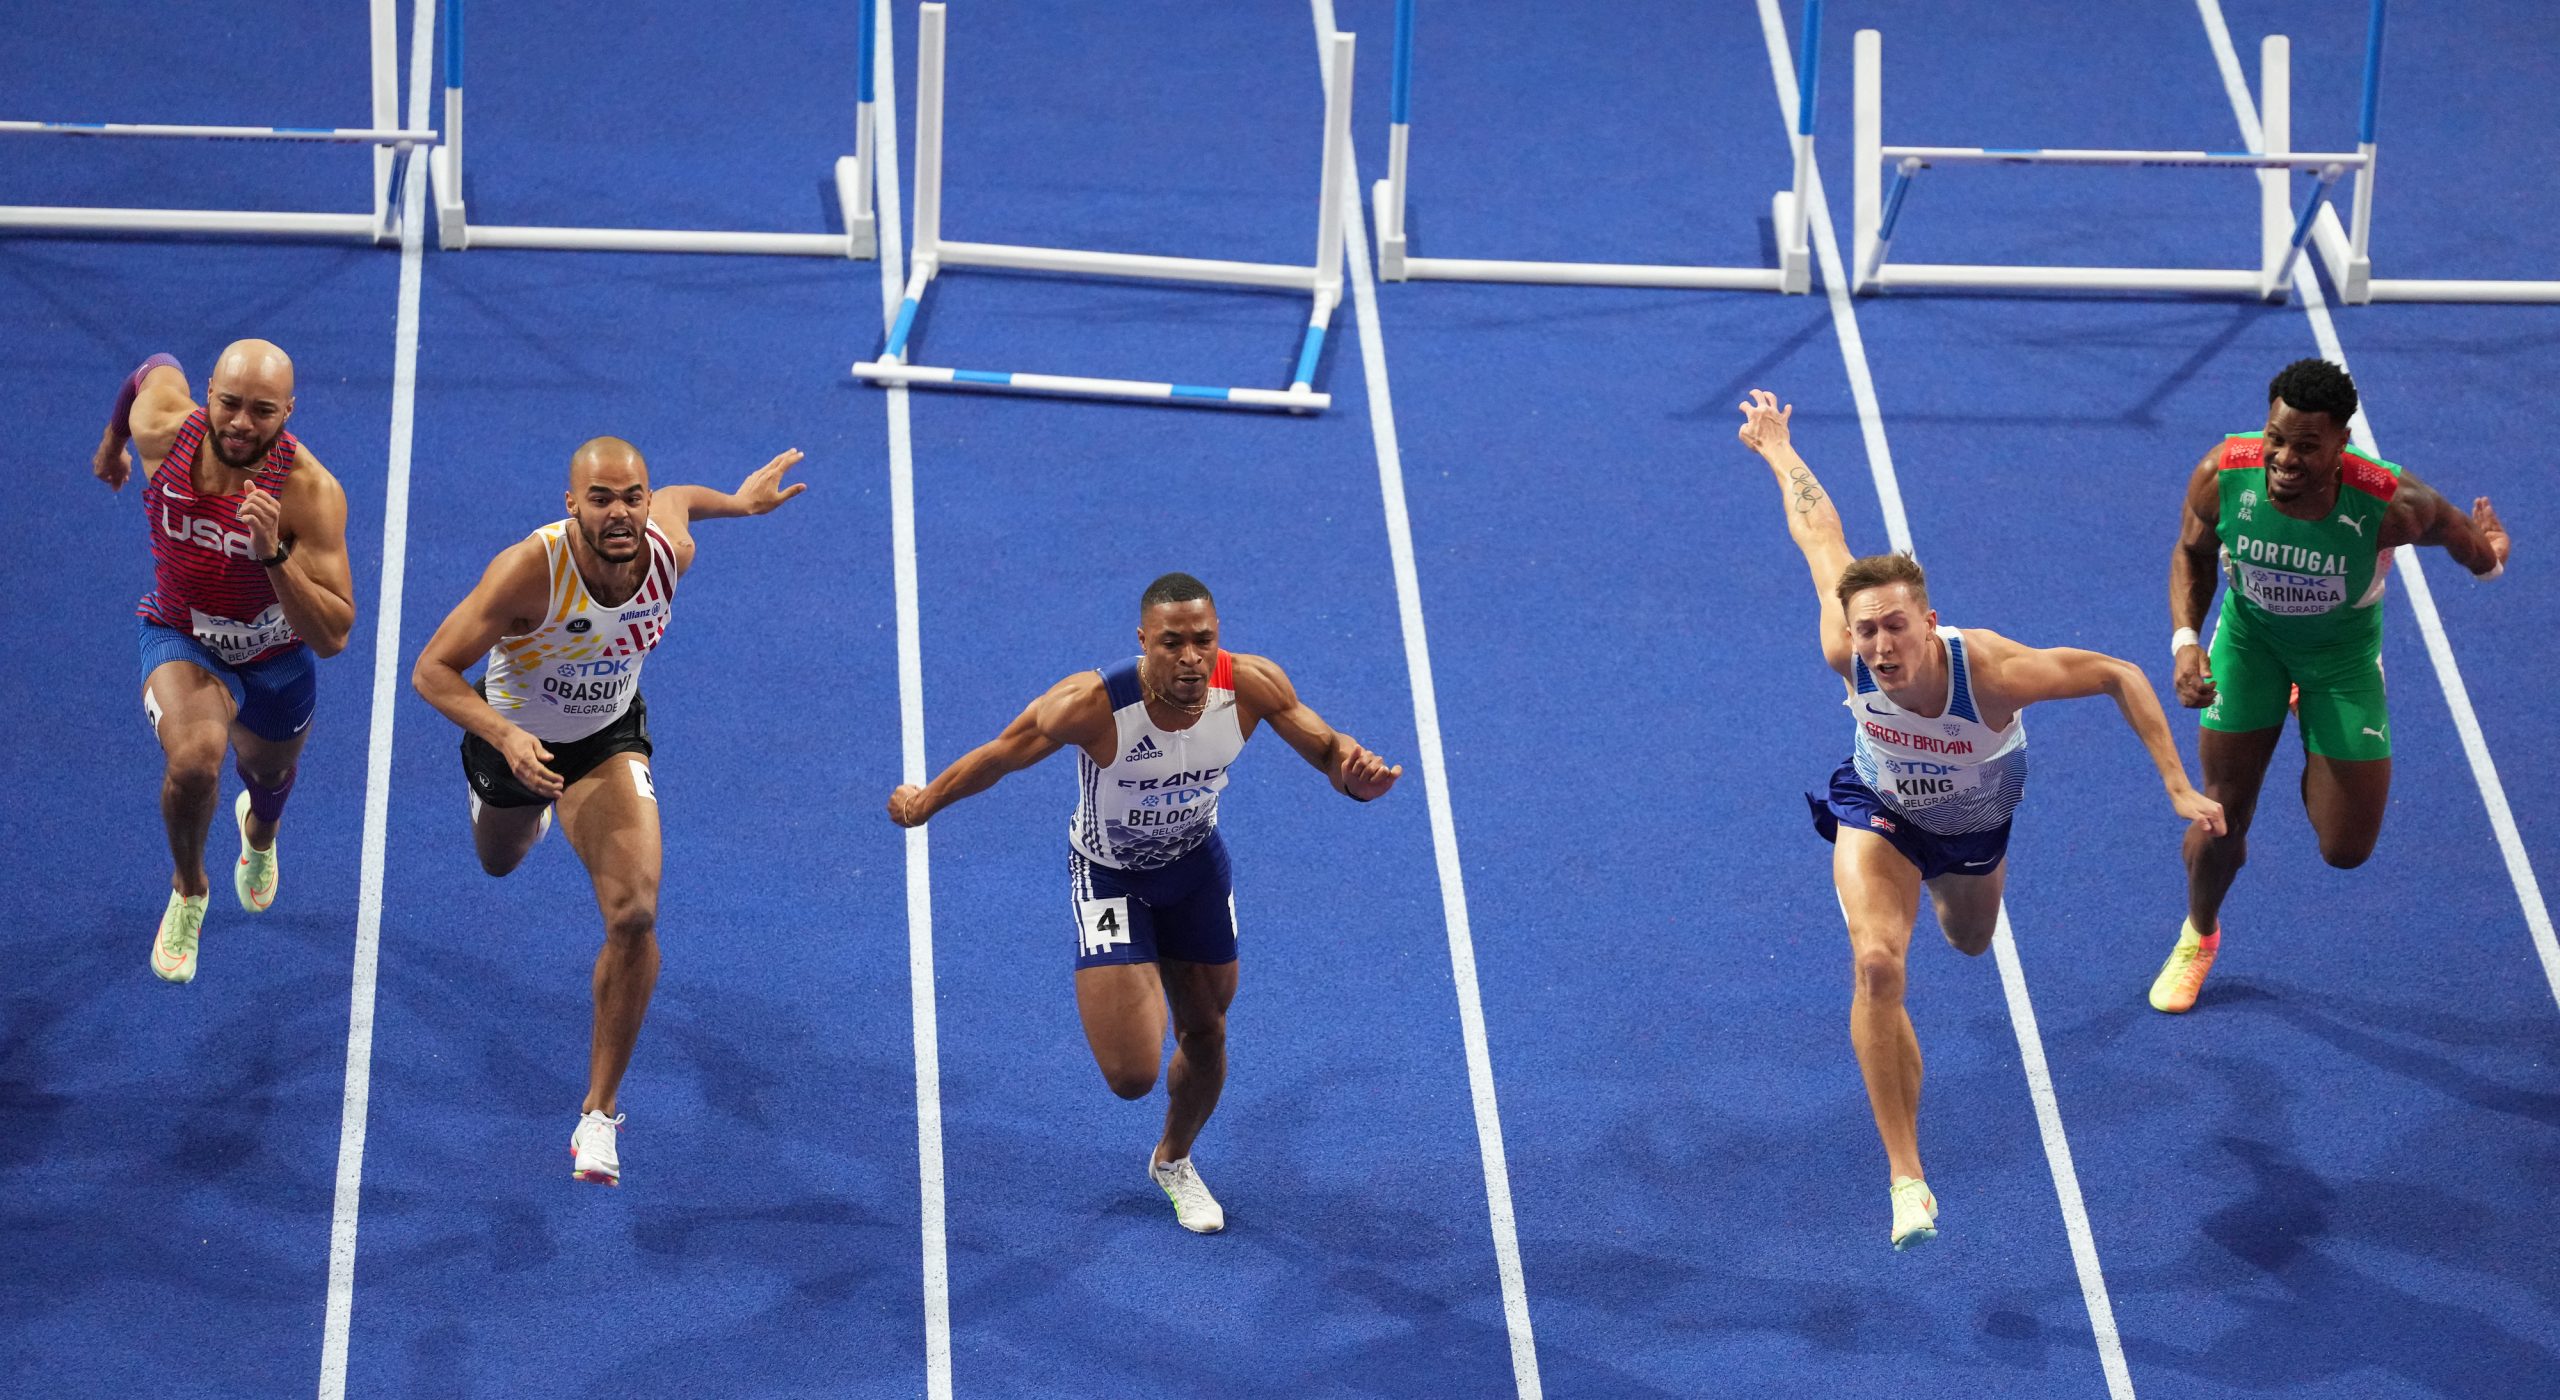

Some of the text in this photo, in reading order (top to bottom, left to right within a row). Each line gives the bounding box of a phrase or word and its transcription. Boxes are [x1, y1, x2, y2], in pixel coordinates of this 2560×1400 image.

[162, 503, 258, 561] USA
[2237, 535, 2348, 575] PORTUGAL
[2246, 576, 2341, 602] LARRINAGA
[2268, 572, 2328, 588] TDK
[619, 609, 650, 622] Allianz
[2268, 603, 2325, 613] BELGRADE
[576, 658, 632, 677] TDK
[543, 673, 632, 701] OBASUYI
[563, 702, 618, 714] BELGRADE
[1866, 721, 1973, 755] GREAT BRITAIN
[1125, 750, 1164, 762] adidas
[1900, 762, 1962, 775] TDK
[1161, 786, 1215, 806] TDK
[1896, 778, 1954, 796] KING
[1904, 791, 1960, 808] BELGRADE
[1097, 908, 1121, 937] 4
